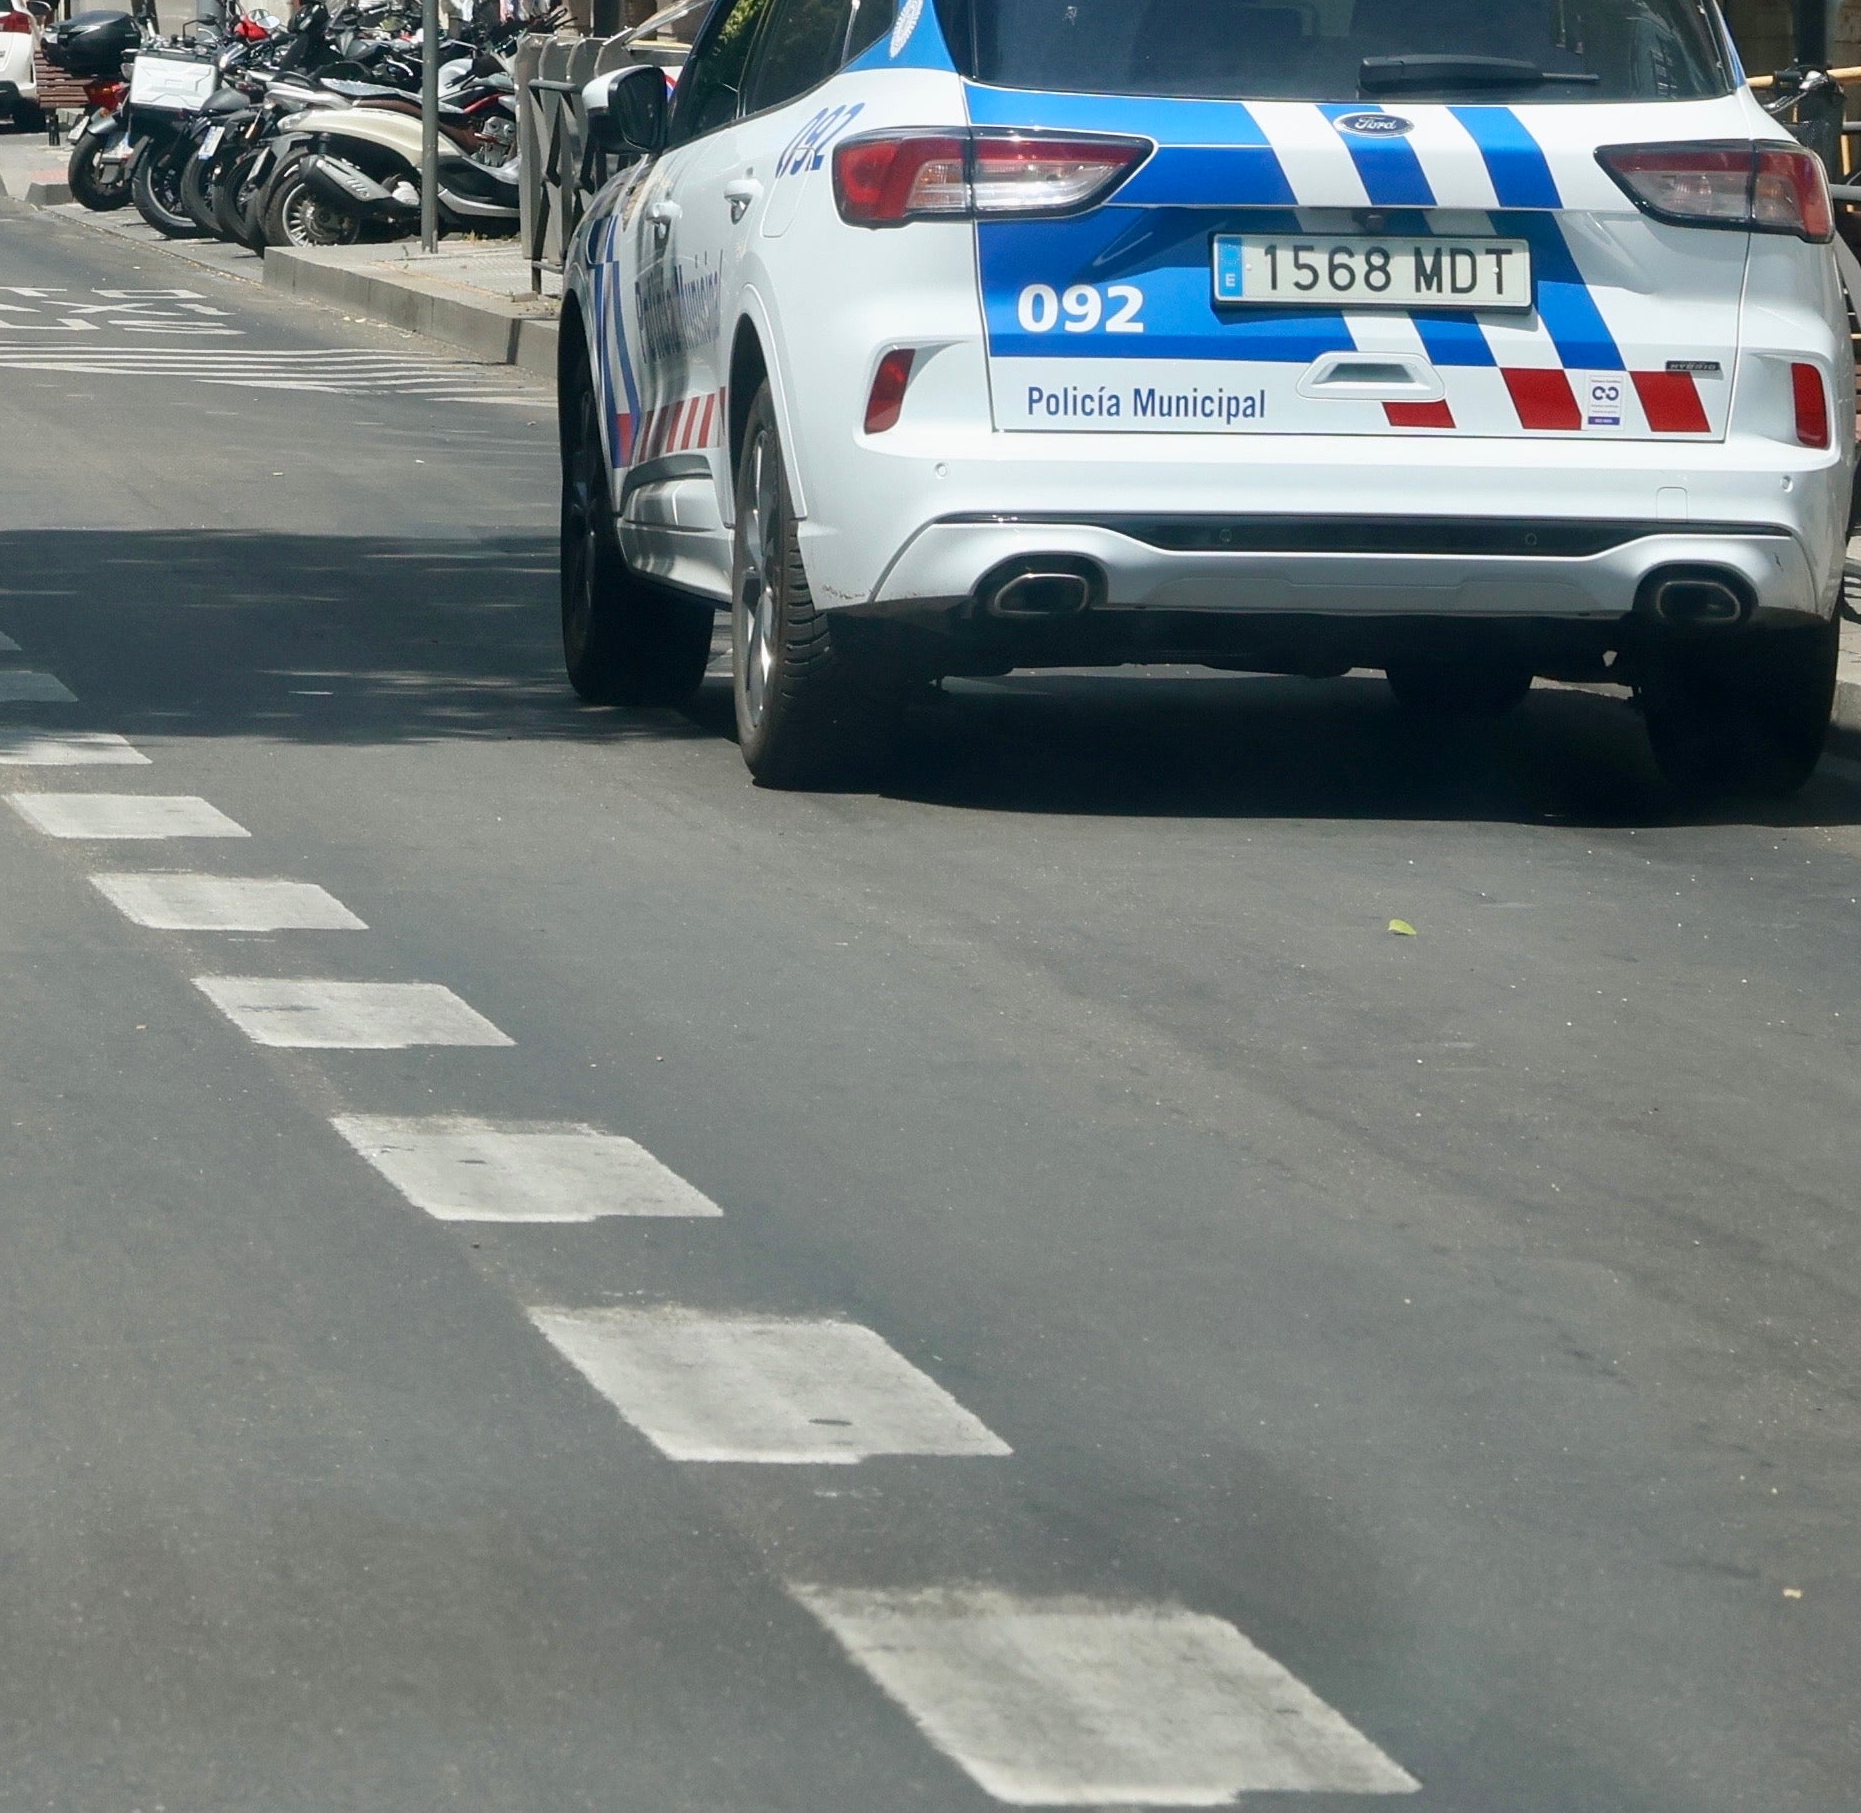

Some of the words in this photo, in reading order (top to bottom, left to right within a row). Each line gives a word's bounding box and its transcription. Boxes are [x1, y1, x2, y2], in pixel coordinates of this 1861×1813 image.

[775, 102, 866, 179] 092
[1354, 115, 1397, 130] Ford
[1225, 273, 1236, 287] E
[1265, 243, 1392, 292] 1568
[1413, 246, 1513, 295] MDT
[1016, 283, 1145, 333] 092
[1027, 383, 1122, 419] Policía
[1132, 386, 1266, 425] Municipal
